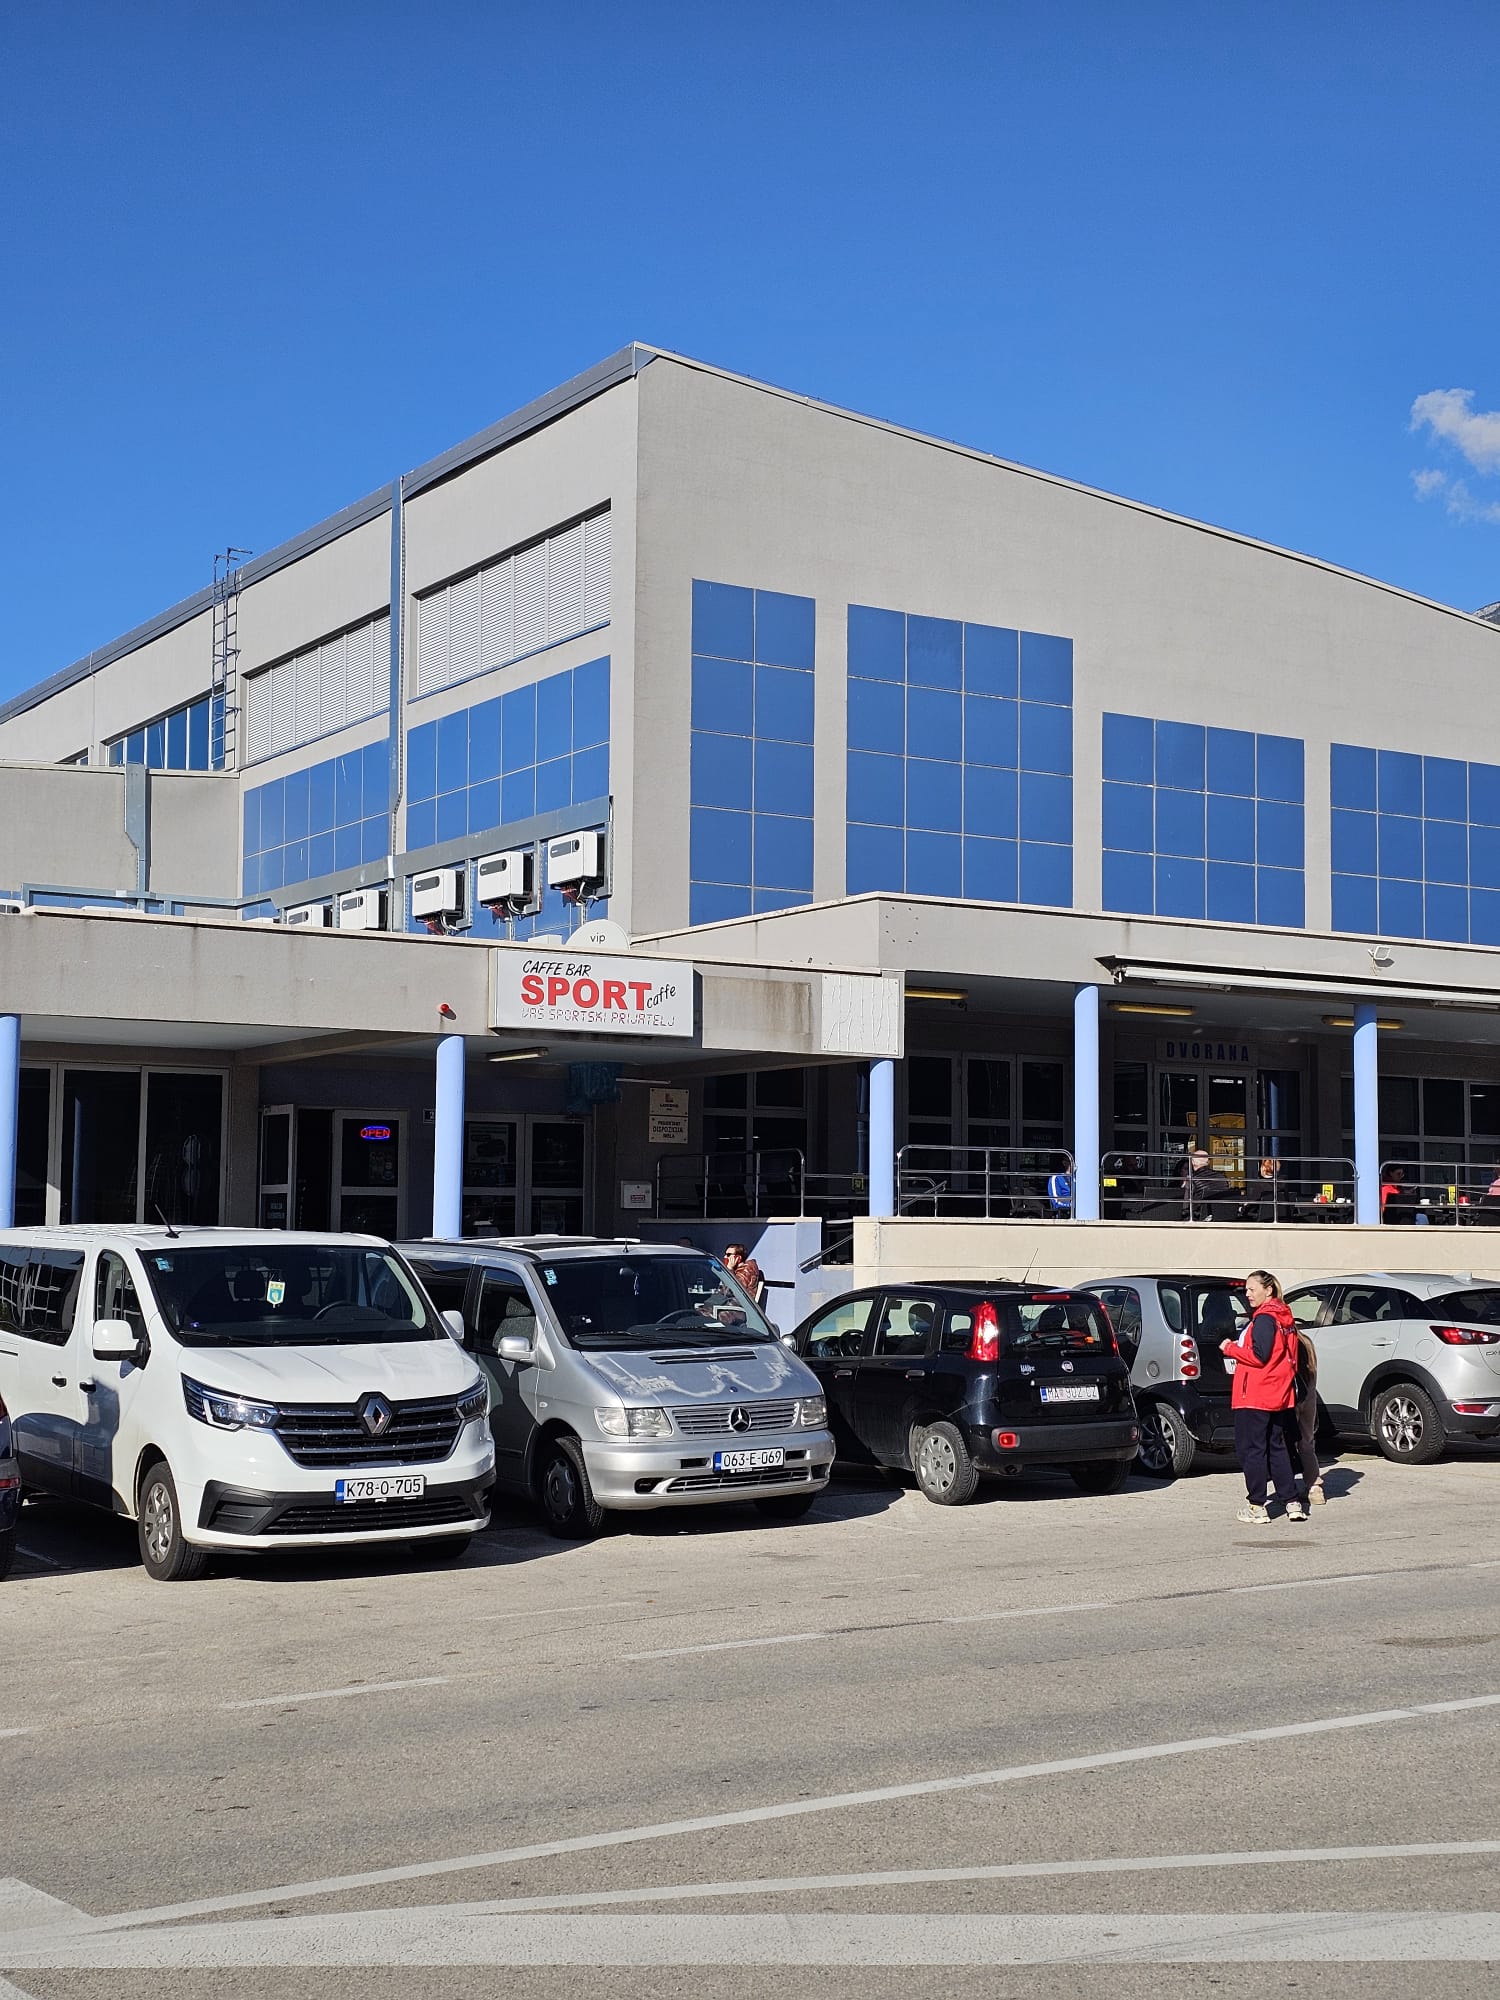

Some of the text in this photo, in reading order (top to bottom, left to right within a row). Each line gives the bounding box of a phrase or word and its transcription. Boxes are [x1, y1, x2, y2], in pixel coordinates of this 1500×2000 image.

[590, 933, 606, 944] vip
[522, 959, 592, 978] CAFFE BAR
[520, 975, 652, 1011] SPORT
[646, 983, 676, 1009] caffe
[548, 1008, 607, 1024] SPORTSKI
[610, 1012, 676, 1027] PRIJATELJ
[1166, 1041, 1250, 1062] DVORANA
[360, 1129, 391, 1139] OPEN
